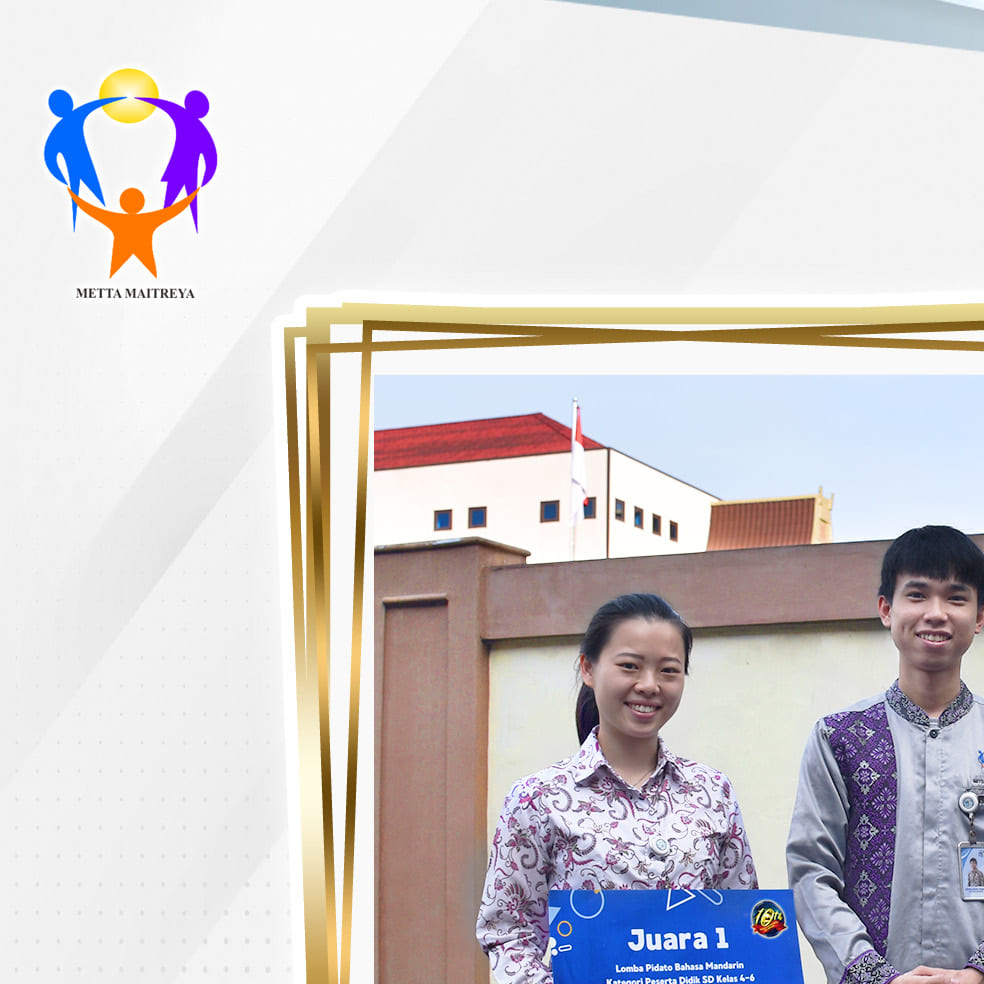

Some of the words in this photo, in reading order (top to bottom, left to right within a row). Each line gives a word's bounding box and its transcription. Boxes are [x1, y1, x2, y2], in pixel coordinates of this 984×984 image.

[627, 928, 708, 952] Juara
[715, 927, 729, 949] 1
[615, 964, 644, 973] Lomba
[645, 963, 674, 972] Pidato
[674, 962, 704, 972] Bahasa
[705, 961, 745, 970] Mandarin
[678, 975, 701, 984] Didik
[702, 975, 715, 984] SD
[716, 974, 739, 983] Kelas
[739, 974, 756, 983] 4-6
